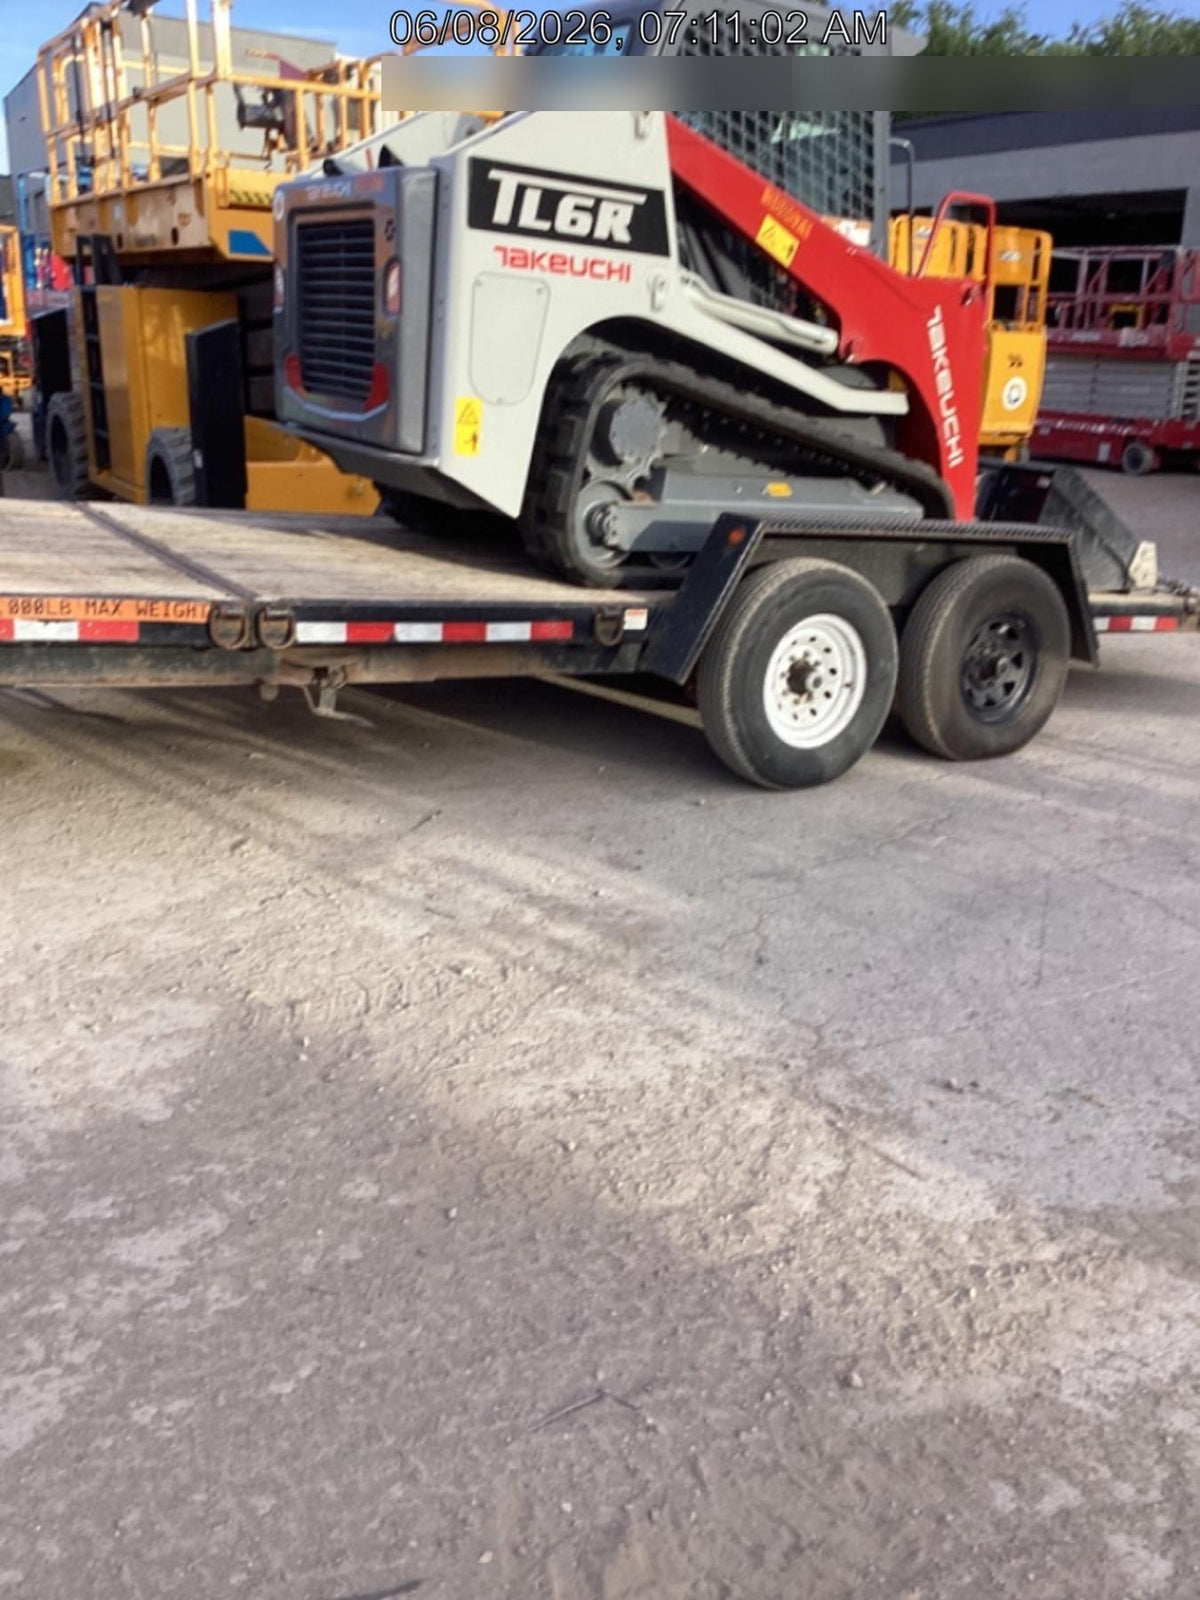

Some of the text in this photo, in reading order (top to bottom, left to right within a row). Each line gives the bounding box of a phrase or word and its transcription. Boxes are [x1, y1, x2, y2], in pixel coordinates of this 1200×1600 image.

[487, 167, 648, 245] TL6R
[85, 600, 123, 617] MAX
[136, 601, 212, 619] WEIGHT
